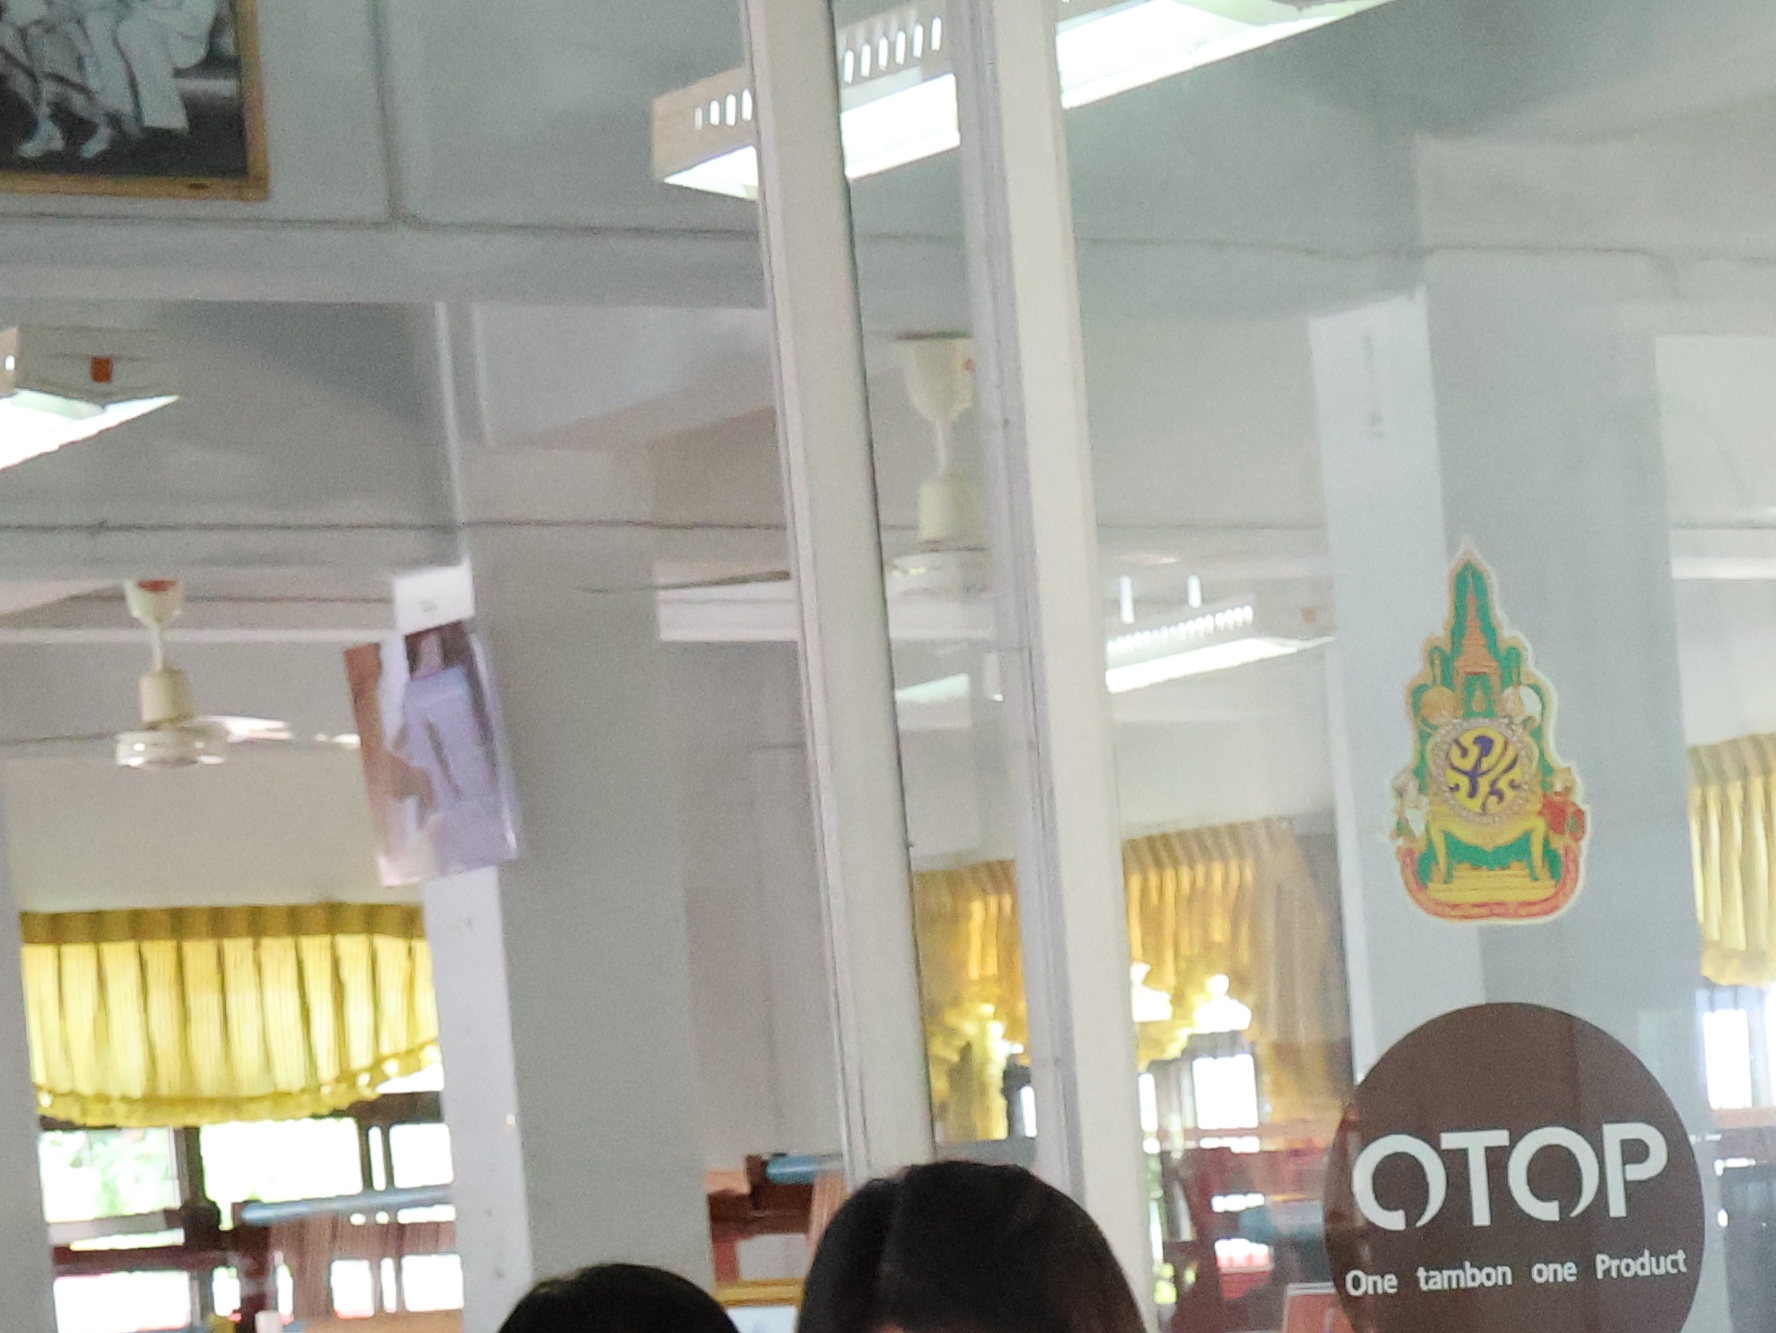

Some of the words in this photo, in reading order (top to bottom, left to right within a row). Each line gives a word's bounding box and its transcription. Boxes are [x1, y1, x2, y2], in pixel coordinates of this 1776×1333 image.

[1352, 1122, 1669, 1232] OTOP
[1345, 1271, 1399, 1298] One
[1416, 1262, 1513, 1290] tambon
[1531, 1259, 1578, 1283] one
[1595, 1249, 1688, 1280] Product
